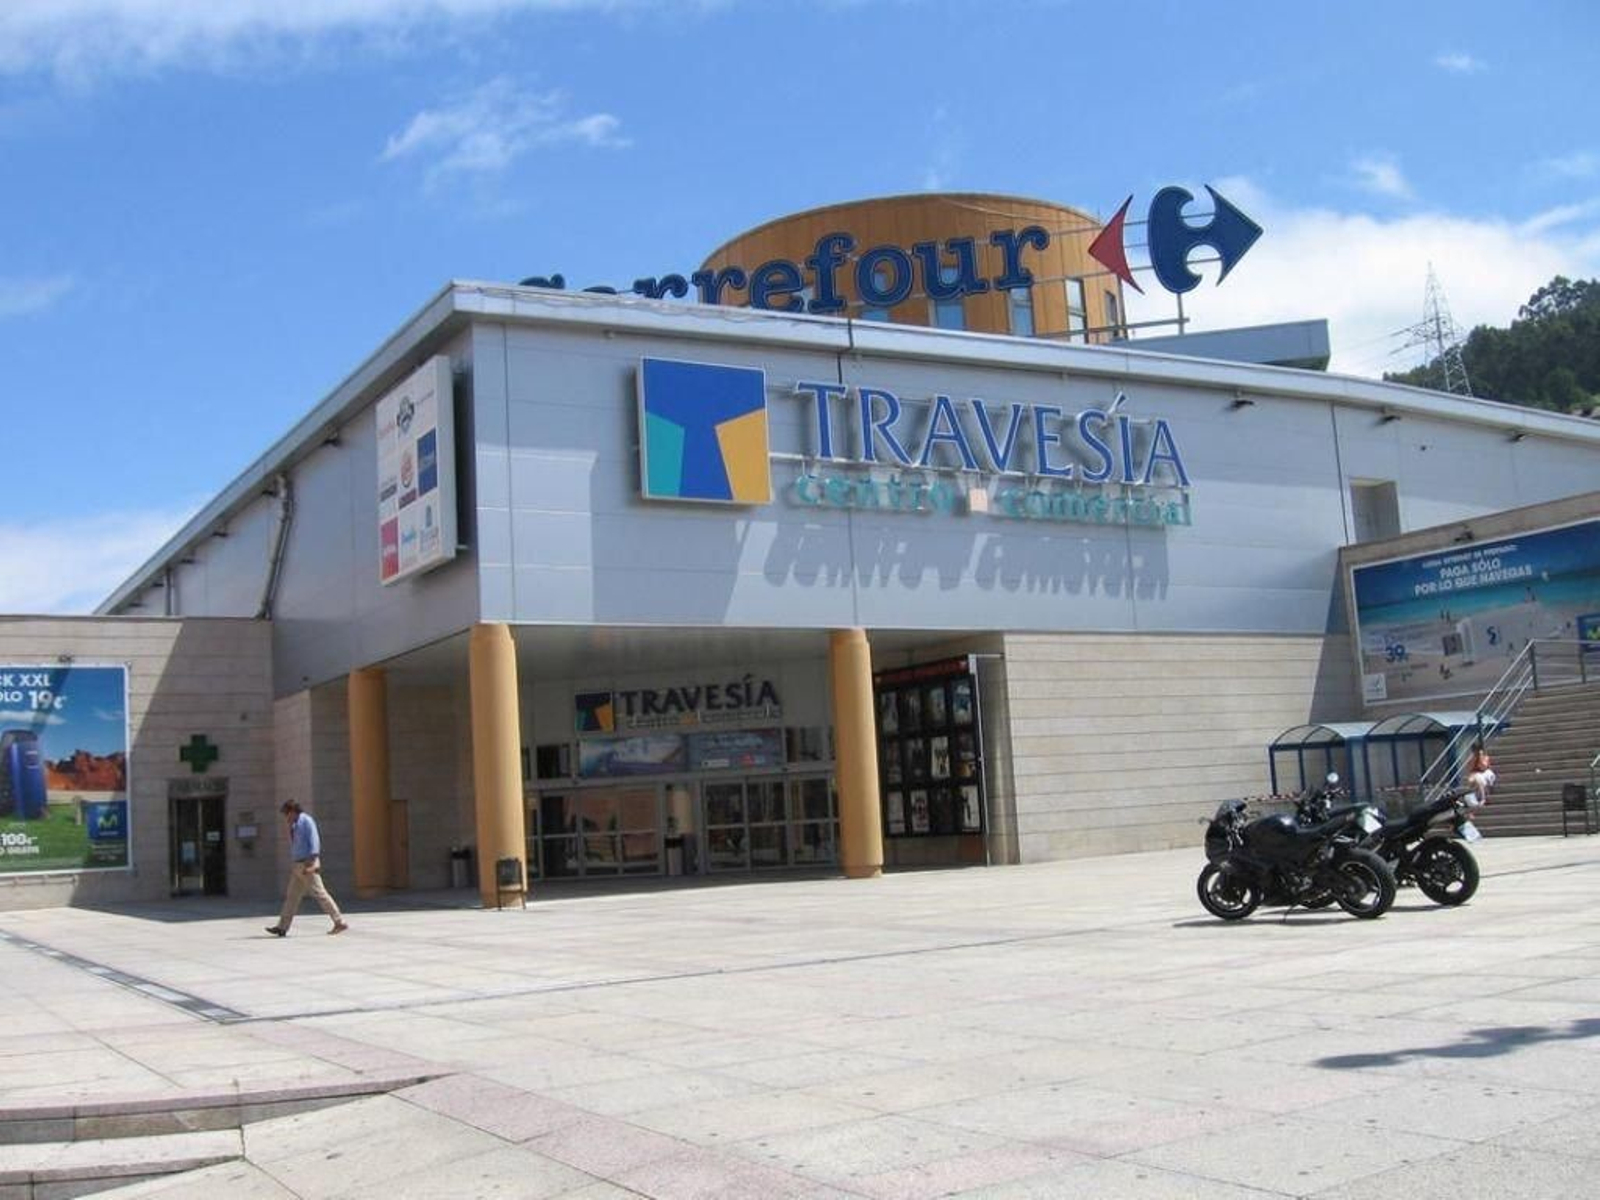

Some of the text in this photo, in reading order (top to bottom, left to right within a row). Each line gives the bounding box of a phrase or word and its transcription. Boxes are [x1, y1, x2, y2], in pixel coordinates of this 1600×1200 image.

[794, 380, 1192, 487] TRAVESÍA
[1414, 564, 1533, 596] POR LO QUE NAVEGAS
[1440, 564, 1470, 579] PAGA
[19, 673, 51, 687] XXL
[618, 673, 780, 717] TRAVESÍA
